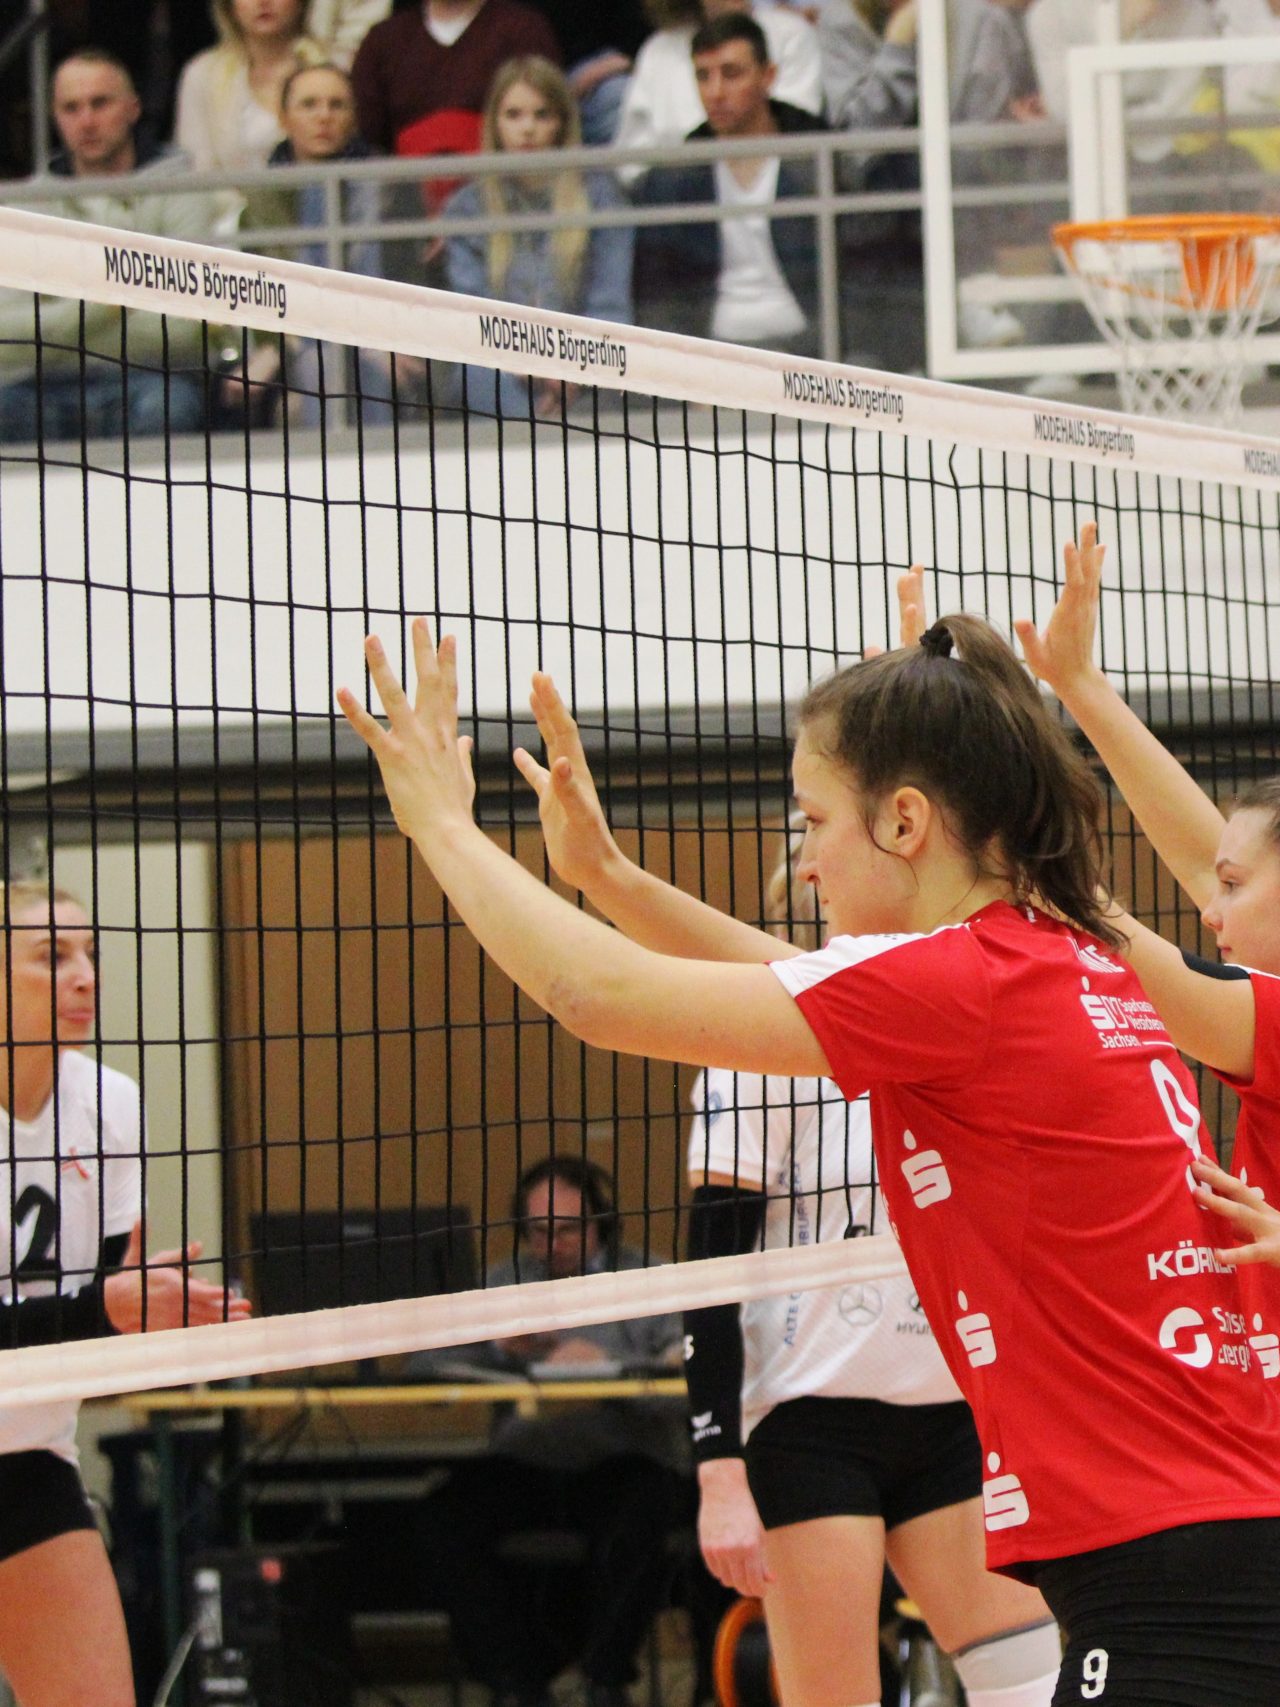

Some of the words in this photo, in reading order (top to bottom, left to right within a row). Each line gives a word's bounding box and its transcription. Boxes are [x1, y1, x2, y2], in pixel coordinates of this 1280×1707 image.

[104, 246, 198, 296] MODEHAUS
[202, 262, 287, 319] Börgerding
[479, 315, 555, 358] MODEHAUS
[558, 328, 627, 377] Börgerding
[783, 370, 846, 407] MODEHAUS
[847, 380, 904, 423] Börgerding
[1034, 413, 1085, 446] MODEHAUS
[1080, 1648, 1109, 1699] 9
